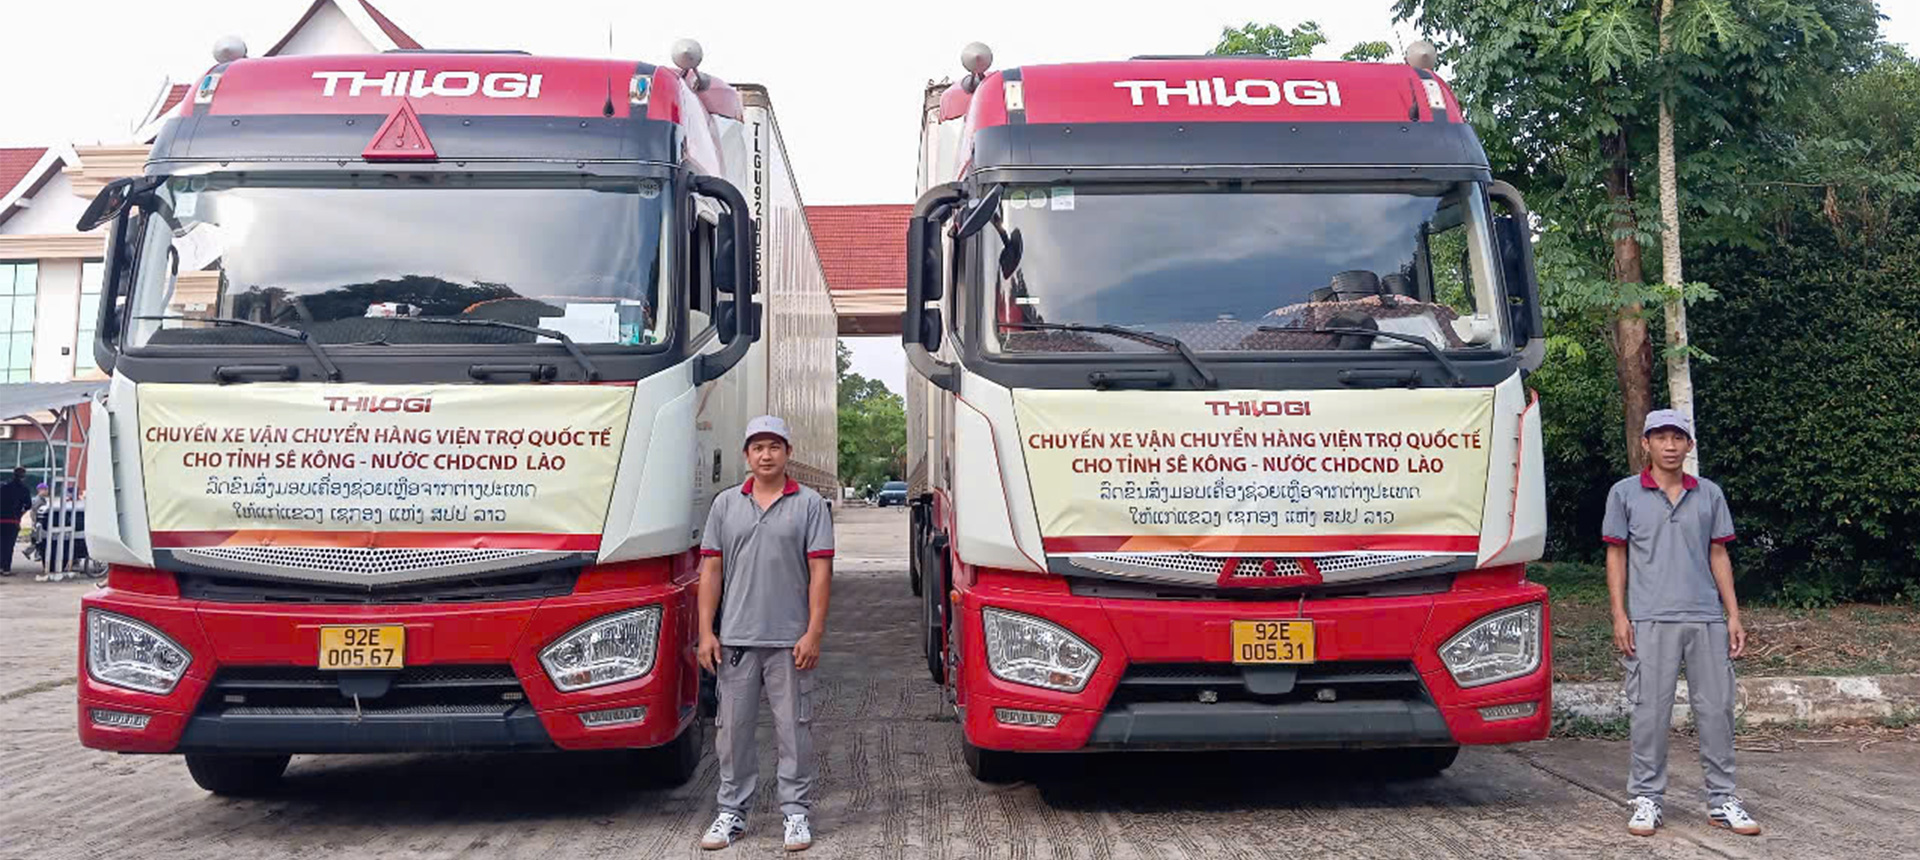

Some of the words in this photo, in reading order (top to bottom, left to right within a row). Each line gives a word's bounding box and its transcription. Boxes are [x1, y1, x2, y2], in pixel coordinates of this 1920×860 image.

[311, 69, 543, 98] THILOGI
[1113, 77, 1341, 107] THILOGI
[324, 396, 432, 413] THILOGI
[1205, 400, 1311, 417] THILOGI
[146, 422, 217, 443] CHUYẾN
[221, 427, 245, 443] XE
[250, 425, 288, 447] VẬN
[292, 422, 370, 443] CHUYỂN
[374, 425, 432, 445] HÀNG
[436, 427, 481, 448] VIỆN
[485, 428, 525, 449] TRỢ
[528, 425, 585, 448] QUỐC
[589, 427, 612, 447] TẾ
[1028, 428, 1105, 449] CHUYẾN
[1110, 433, 1133, 449] XE
[1137, 430, 1175, 452] VẬN
[1180, 427, 1258, 448] CHUYỂN
[1262, 429, 1315, 448] HÀNG
[1319, 429, 1362, 451] VIỆN
[1365, 431, 1402, 452] TRỢ
[1406, 428, 1459, 451] QUỐC
[1461, 428, 1481, 449] TẾ
[183, 452, 222, 468] CHO
[226, 448, 270, 468] TỈNH
[275, 450, 296, 469] SÊ
[301, 450, 355, 469] KÔNG
[371, 450, 430, 469] NƯỚC
[434, 454, 517, 470] CHDCND
[526, 452, 566, 471] LÀO
[1072, 458, 1112, 473] CHO
[1116, 453, 1161, 473] TỈNH
[1166, 455, 1189, 473] SÊ
[1193, 454, 1247, 473] KÔNG
[1263, 453, 1317, 472] NƯỚC
[1321, 456, 1399, 473] CHDCND
[1408, 456, 1444, 474] LÀO
[474, 508, 506, 522] ລາວ
[1364, 510, 1395, 524] ລາວ
[344, 628, 380, 646] 92E
[1255, 623, 1290, 640] 92E
[328, 649, 394, 666] 005.67
[1242, 643, 1304, 660] 005.31
